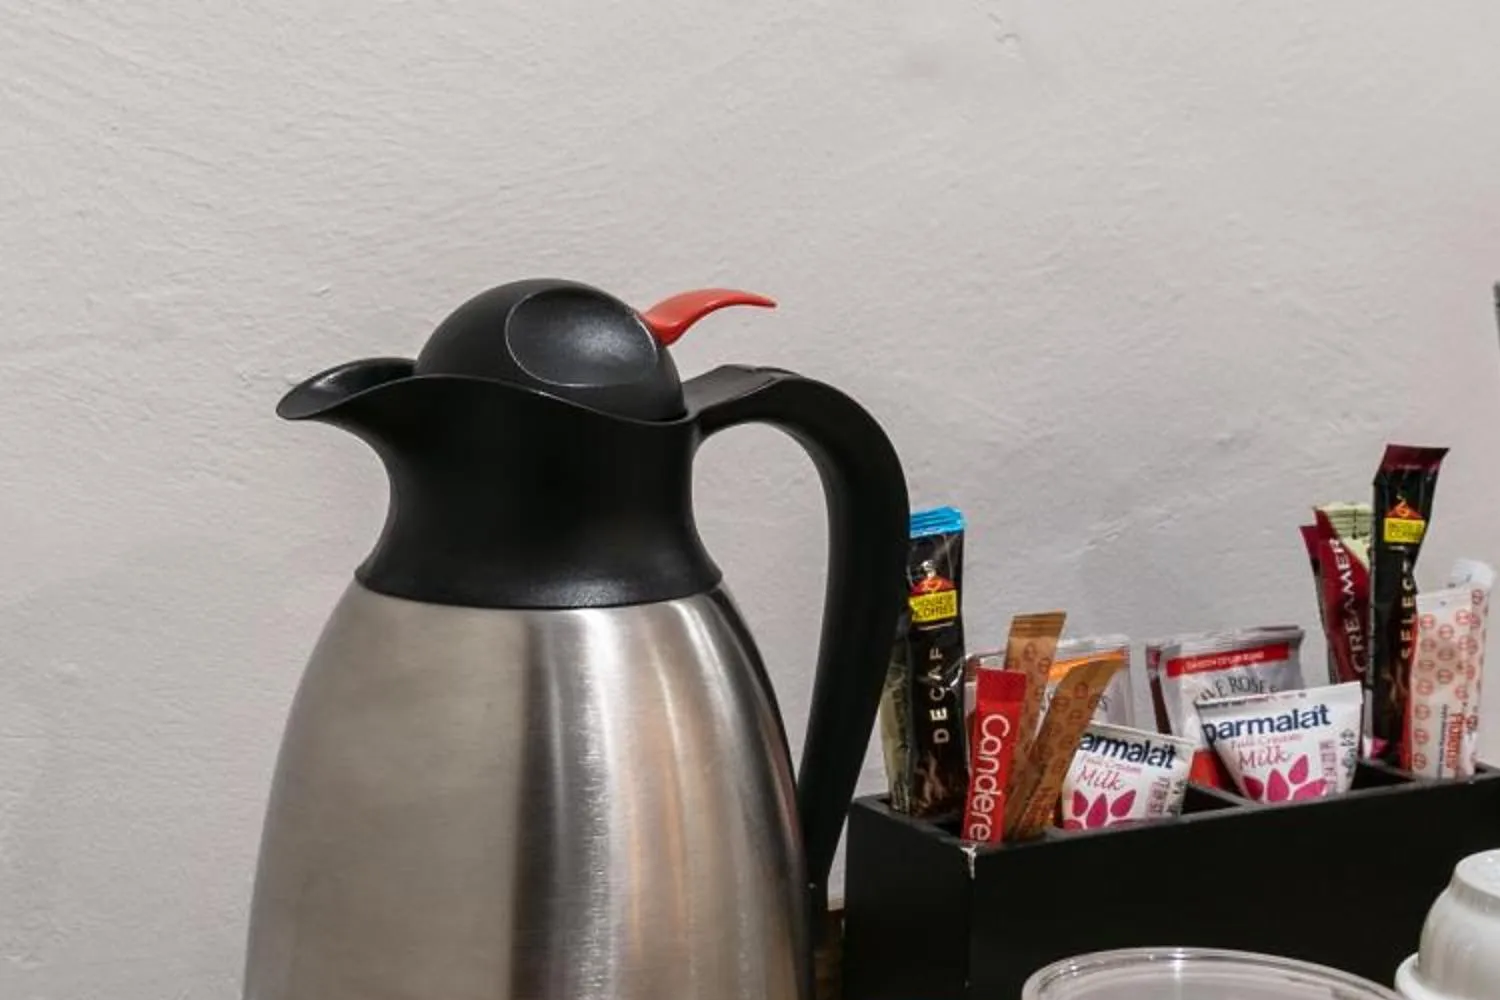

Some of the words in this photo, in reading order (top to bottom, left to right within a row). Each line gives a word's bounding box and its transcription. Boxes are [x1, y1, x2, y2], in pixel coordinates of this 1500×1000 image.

[1328, 537, 1367, 673] CREAMER
[1401, 556, 1414, 659] SELECT
[928, 647, 949, 744] DECAF
[1202, 704, 1332, 747] parmalat
[969, 713, 1010, 840] Candere
[1076, 765, 1122, 791] Milk
[1080, 732, 1177, 768] armalat
[1239, 746, 1288, 769] Milk
